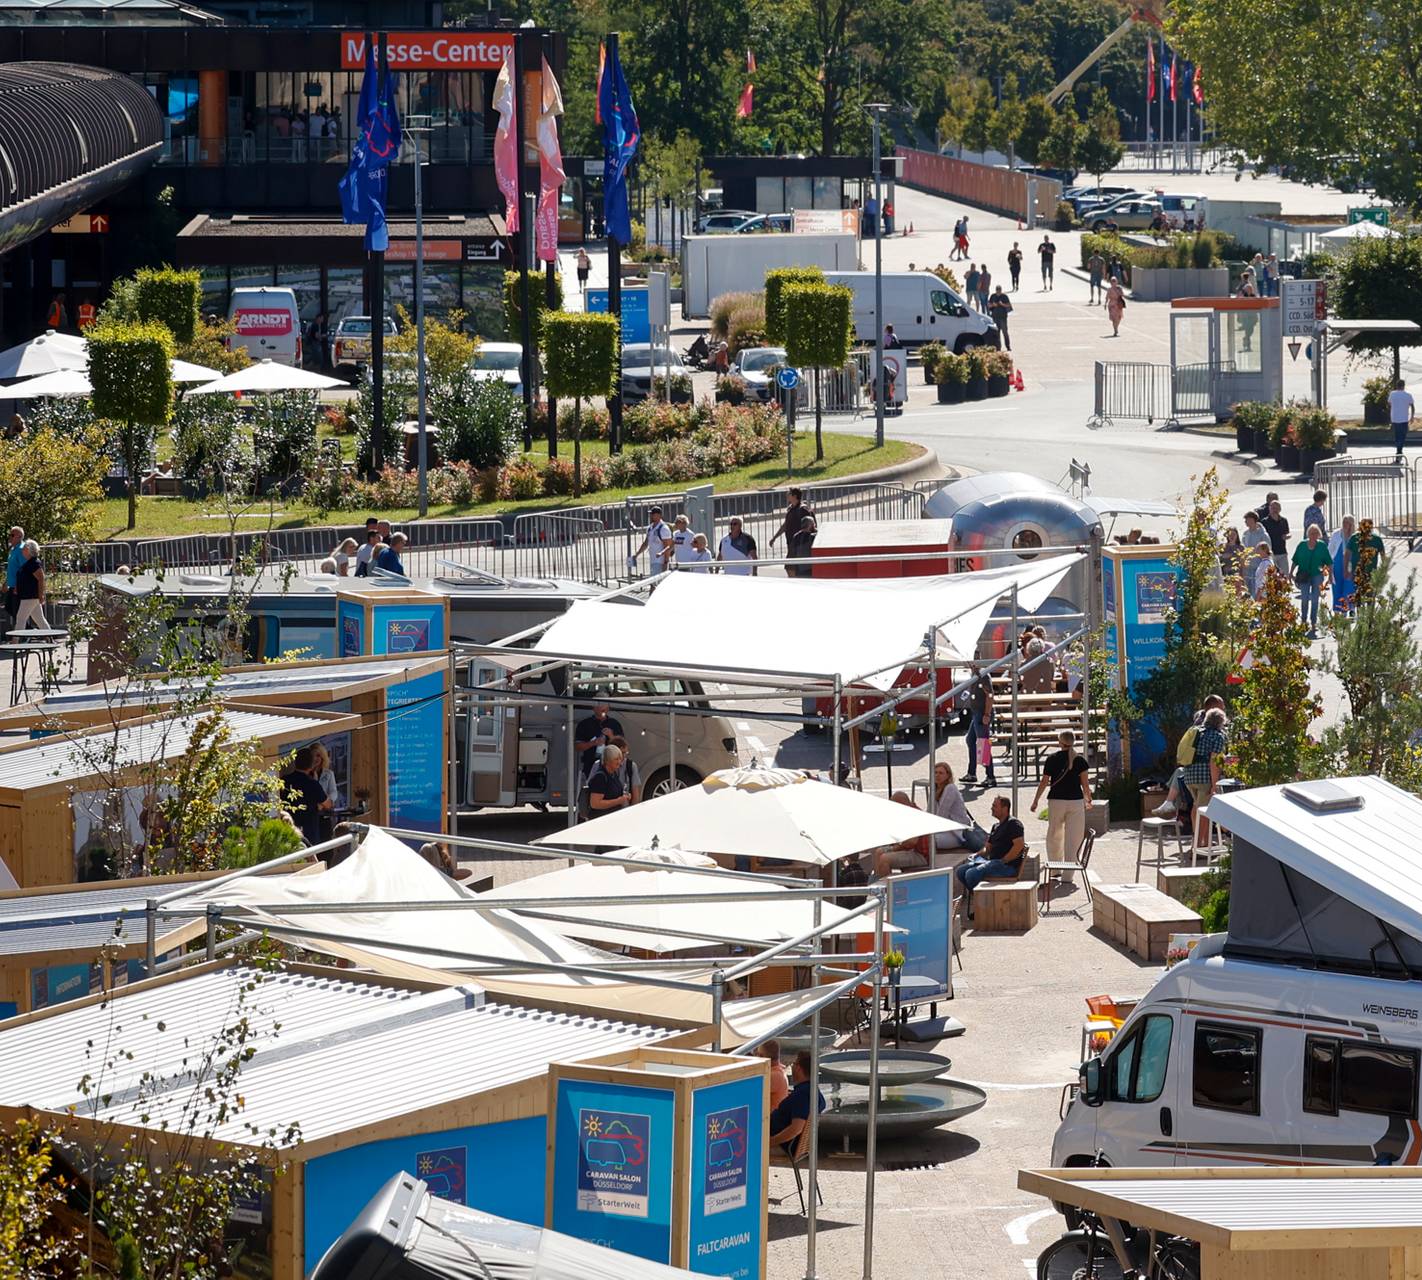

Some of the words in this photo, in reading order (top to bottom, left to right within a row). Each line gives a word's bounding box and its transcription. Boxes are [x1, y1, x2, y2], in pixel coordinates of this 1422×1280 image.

[236, 314, 290, 329] ARNDT
[1362, 1003, 1419, 1020] WEINSBERG
[585, 1171, 619, 1180] CARAVAN
[619, 1173, 641, 1183] SALON
[709, 1170, 728, 1181] CARAVAN
[727, 1167, 743, 1177] SALON
[593, 1180, 634, 1190] DÜSSELDORF
[598, 1198, 641, 1210] StarterWelt
[715, 1193, 742, 1206] StarterWelt
[697, 1231, 751, 1256] FALTCARAVAN
